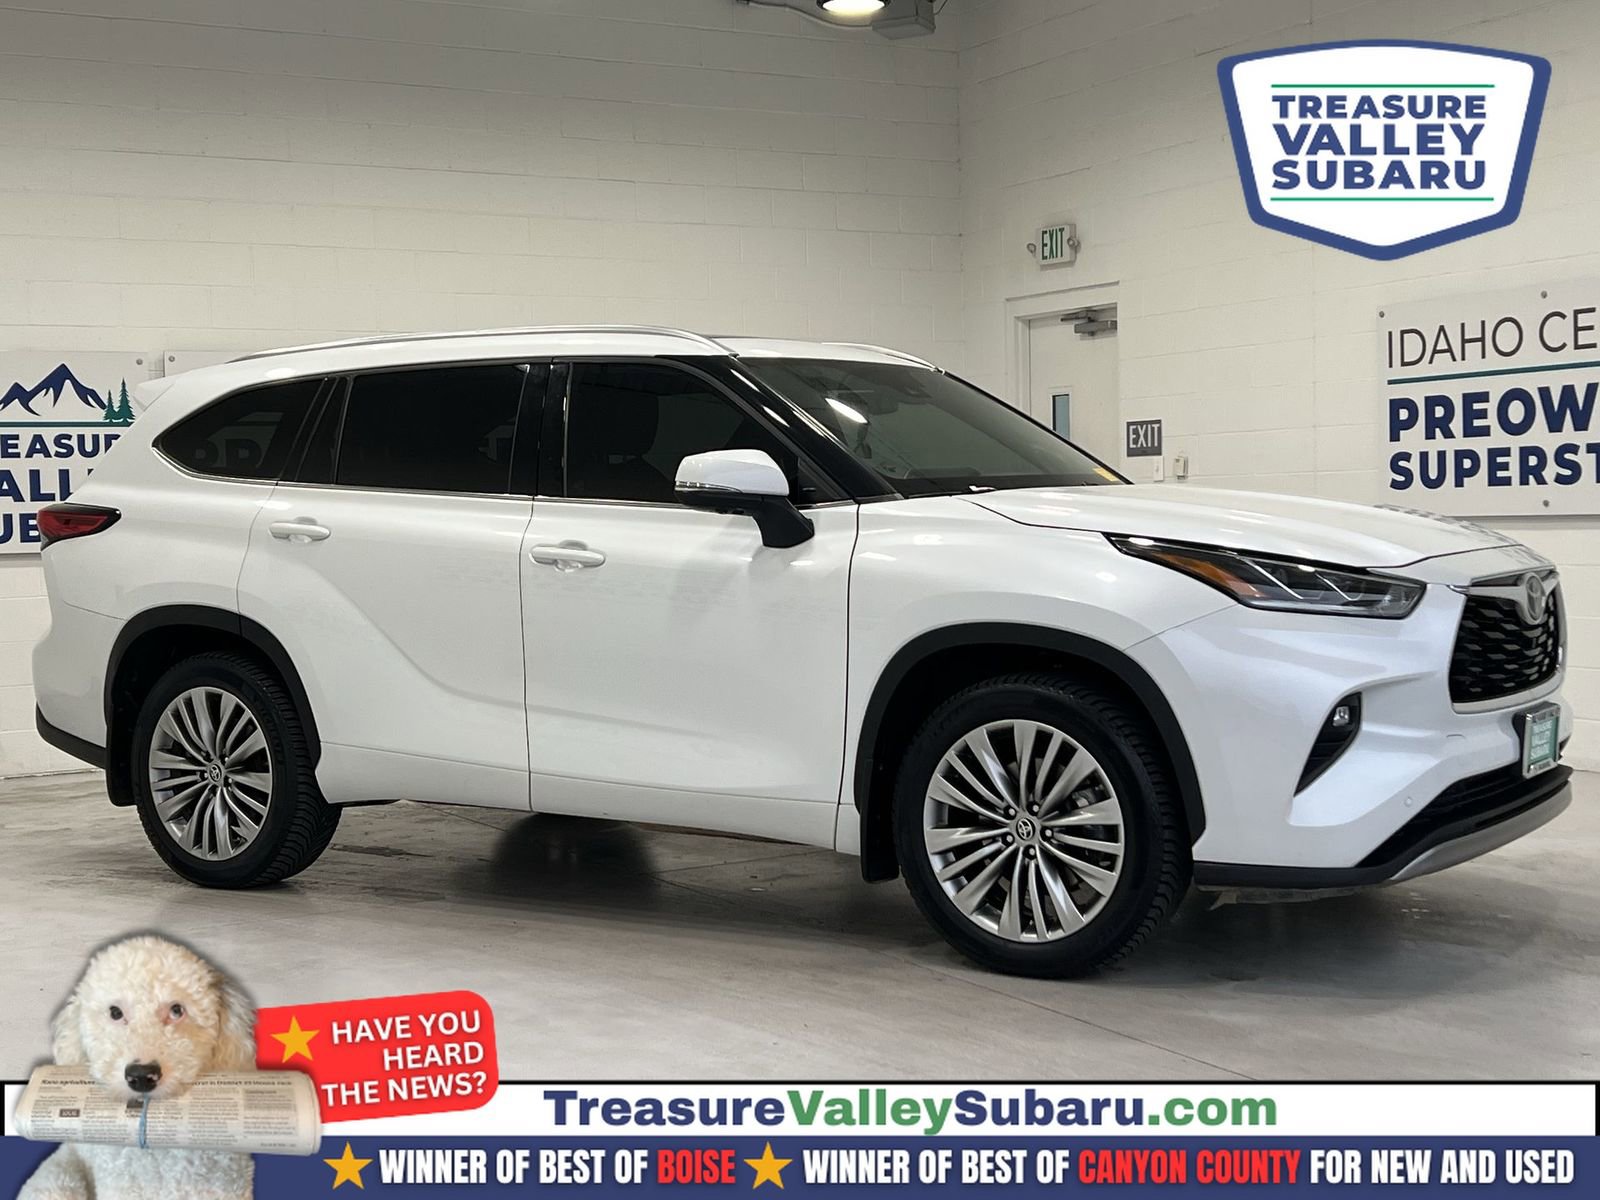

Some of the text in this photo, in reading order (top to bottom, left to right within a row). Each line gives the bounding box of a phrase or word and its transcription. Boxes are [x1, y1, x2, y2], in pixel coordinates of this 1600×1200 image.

[1041, 227, 1065, 261] EXIT
[1388, 307, 1598, 369] IDAHO CE
[1388, 382, 1600, 443] PREOW
[1129, 423, 1160, 449] EXIT
[0, 469, 94, 502] ALL
